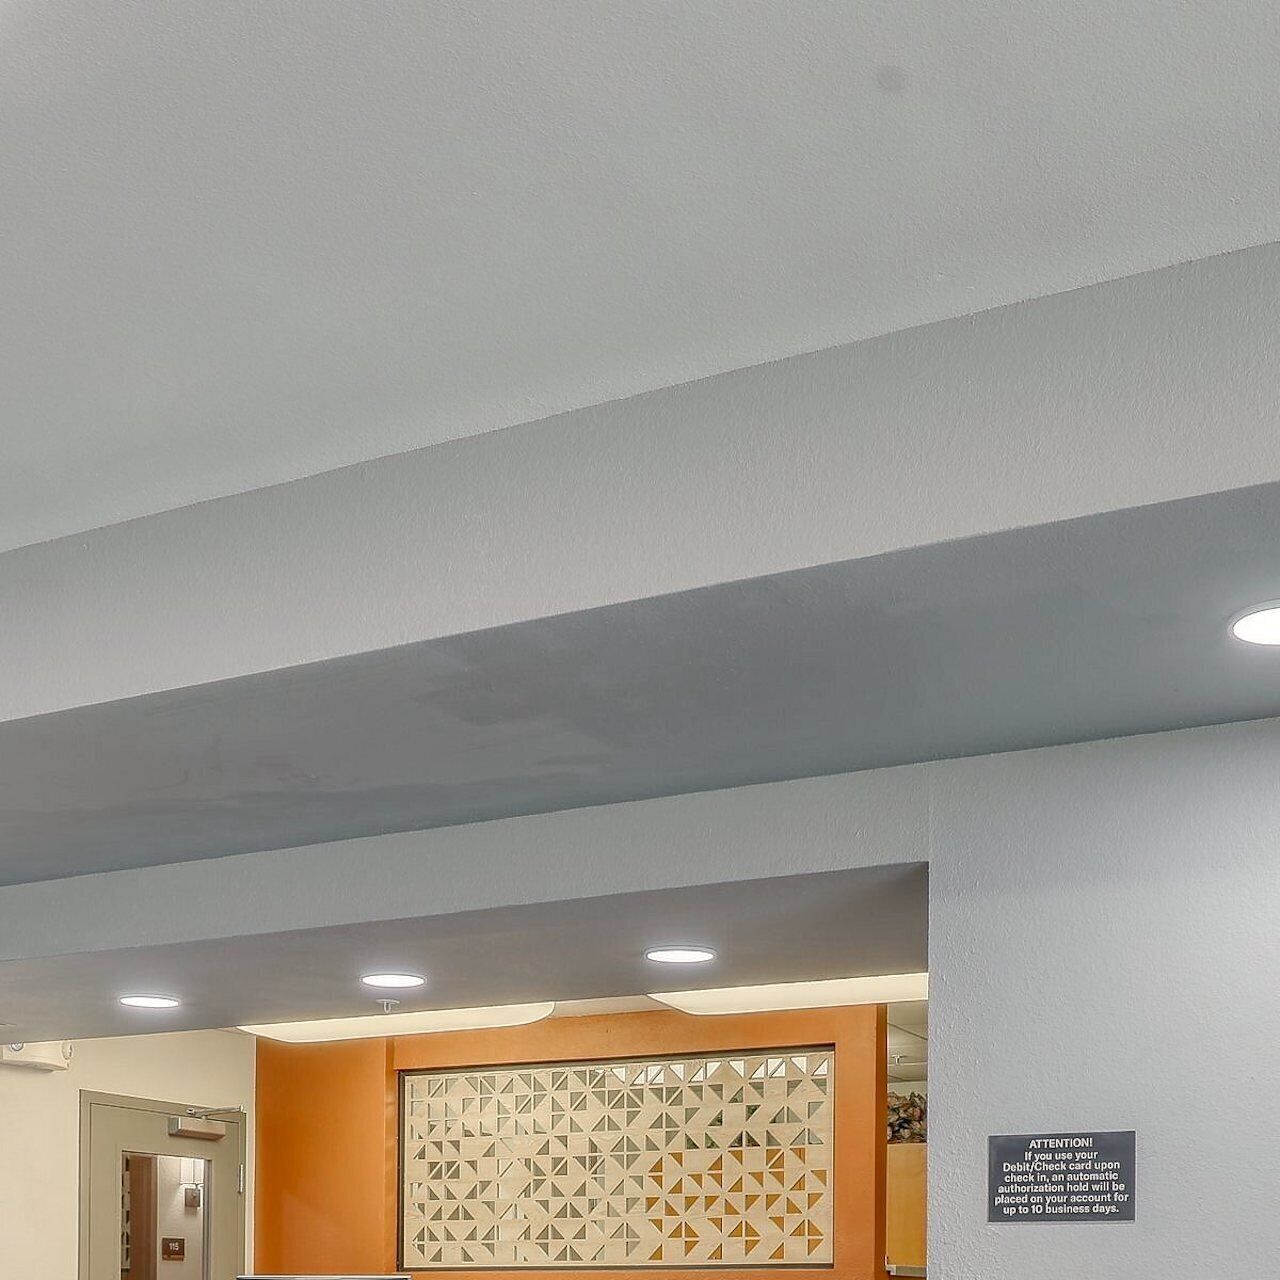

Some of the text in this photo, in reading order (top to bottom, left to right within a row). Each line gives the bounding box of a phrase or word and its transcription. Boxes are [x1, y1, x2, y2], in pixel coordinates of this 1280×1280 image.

[1029, 1138, 1093, 1149] ATTENTION!
[1024, 1151, 1098, 1162] If you use your
[1003, 1160, 1120, 1172] Debit/Check card upon
[1004, 1171, 1119, 1183] check in, an automatic
[998, 1181, 1125, 1193] authorization hold will be
[994, 1194, 1028, 1206] placed
[1045, 1195, 1068, 1205] your
[1070, 1193, 1112, 1202] account
[1113, 1192, 1129, 1202] for
[1003, 1203, 1120, 1216] up to 10 business days.
